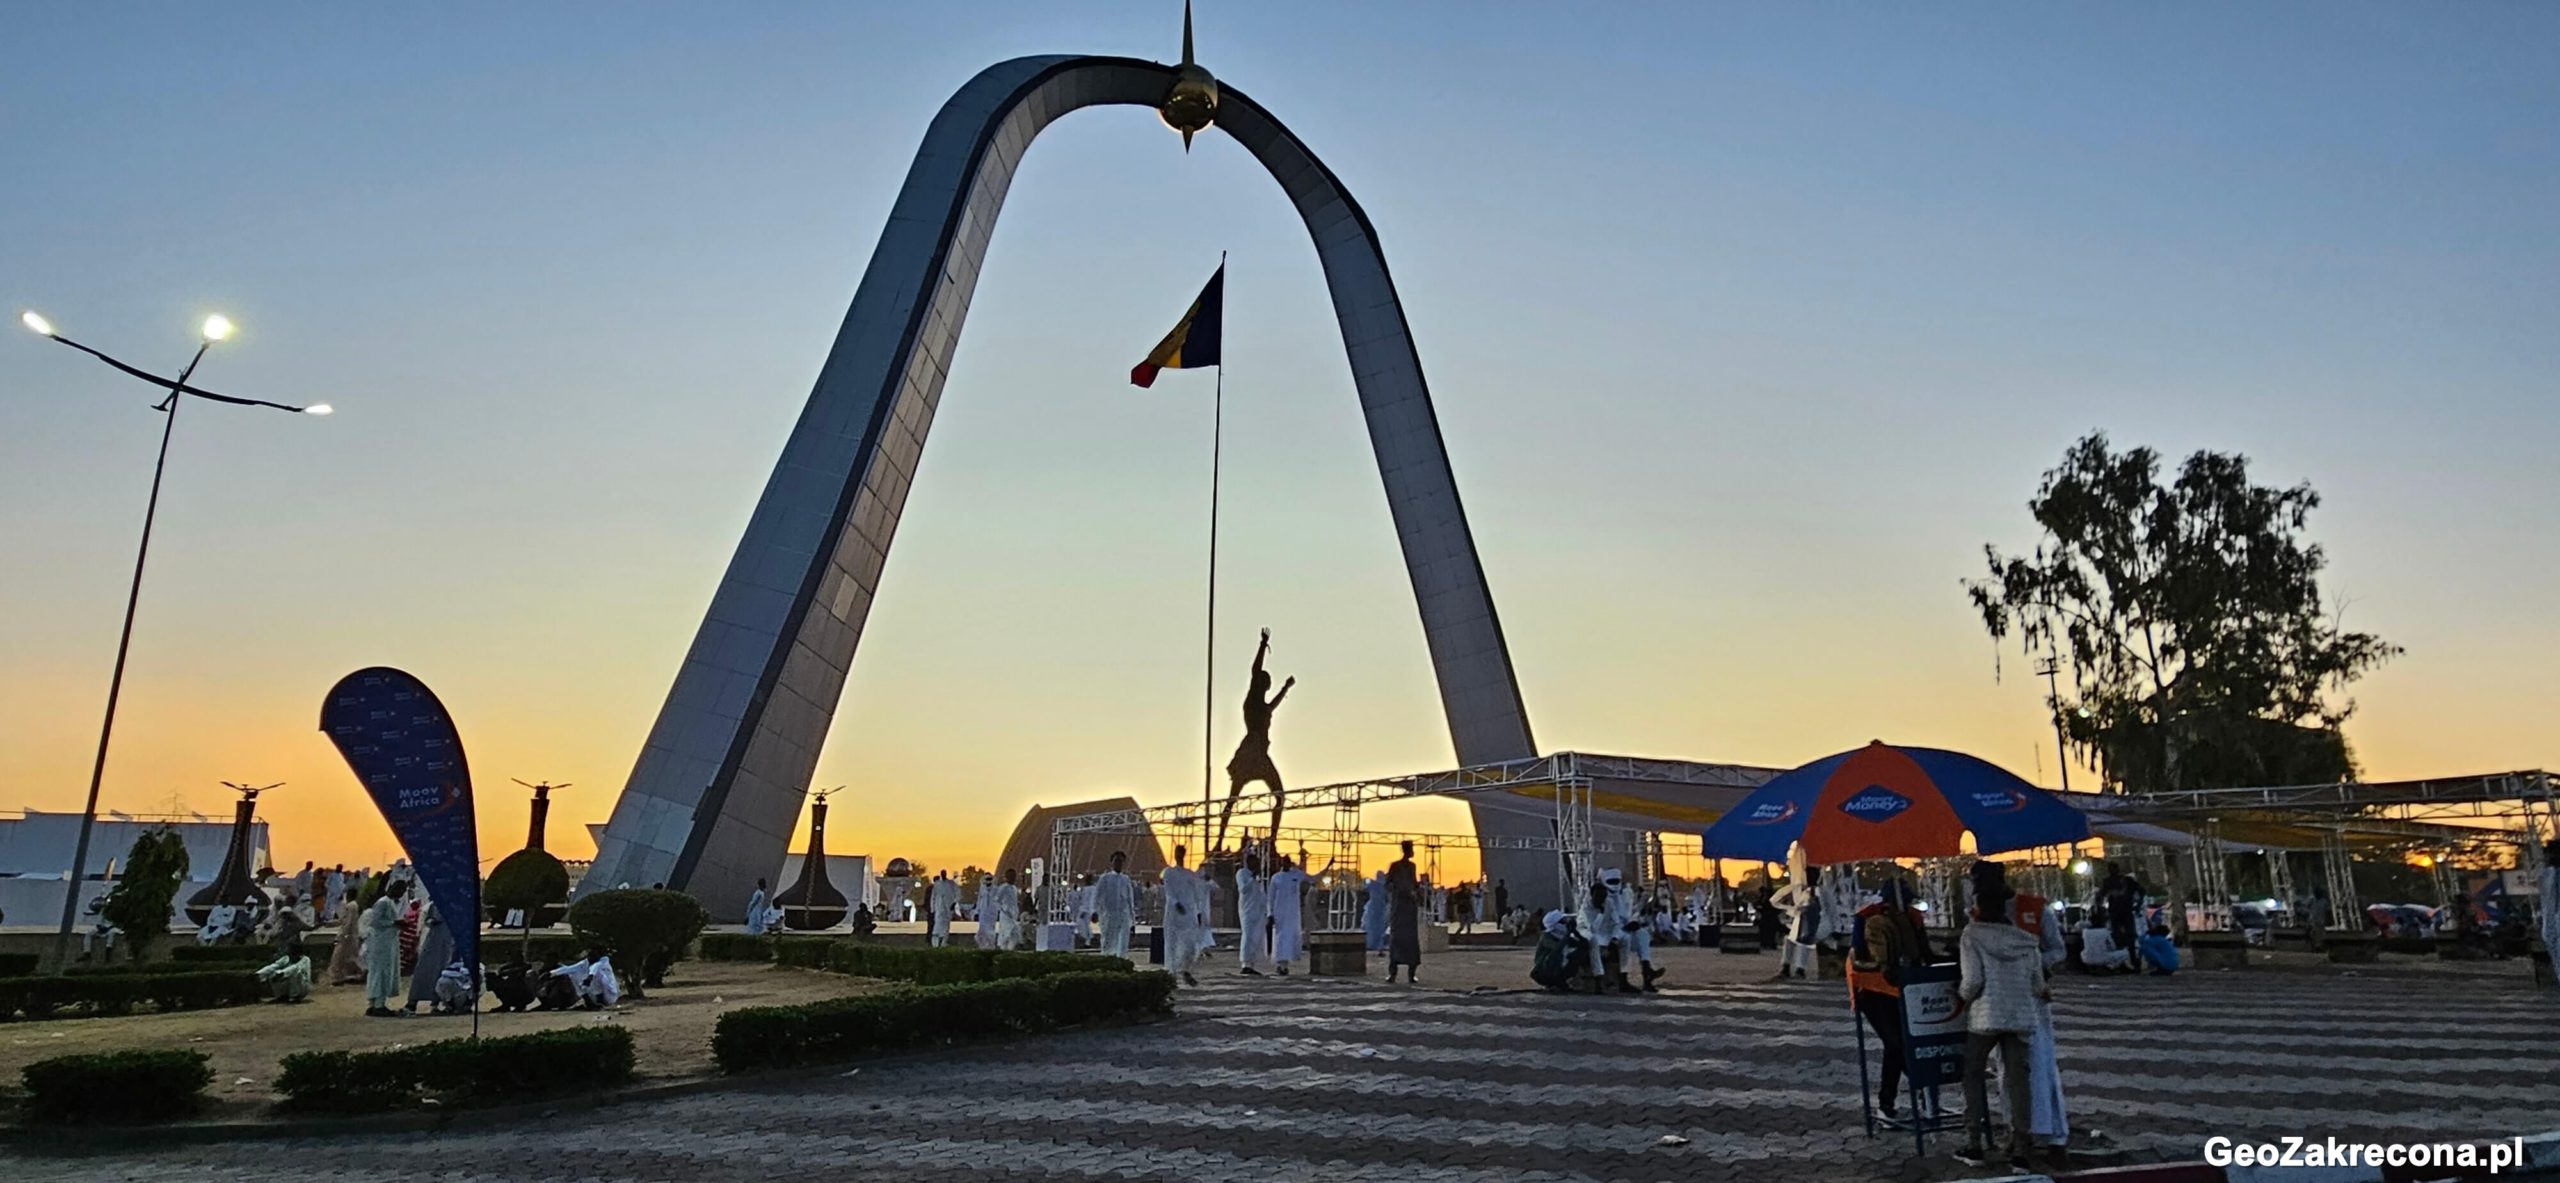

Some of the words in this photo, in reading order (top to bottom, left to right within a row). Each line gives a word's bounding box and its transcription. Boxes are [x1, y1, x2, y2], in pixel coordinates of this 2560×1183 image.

[399, 787, 439, 799] Moov
[400, 798, 440, 808] Africa
[1844, 800, 1899, 812] Money
